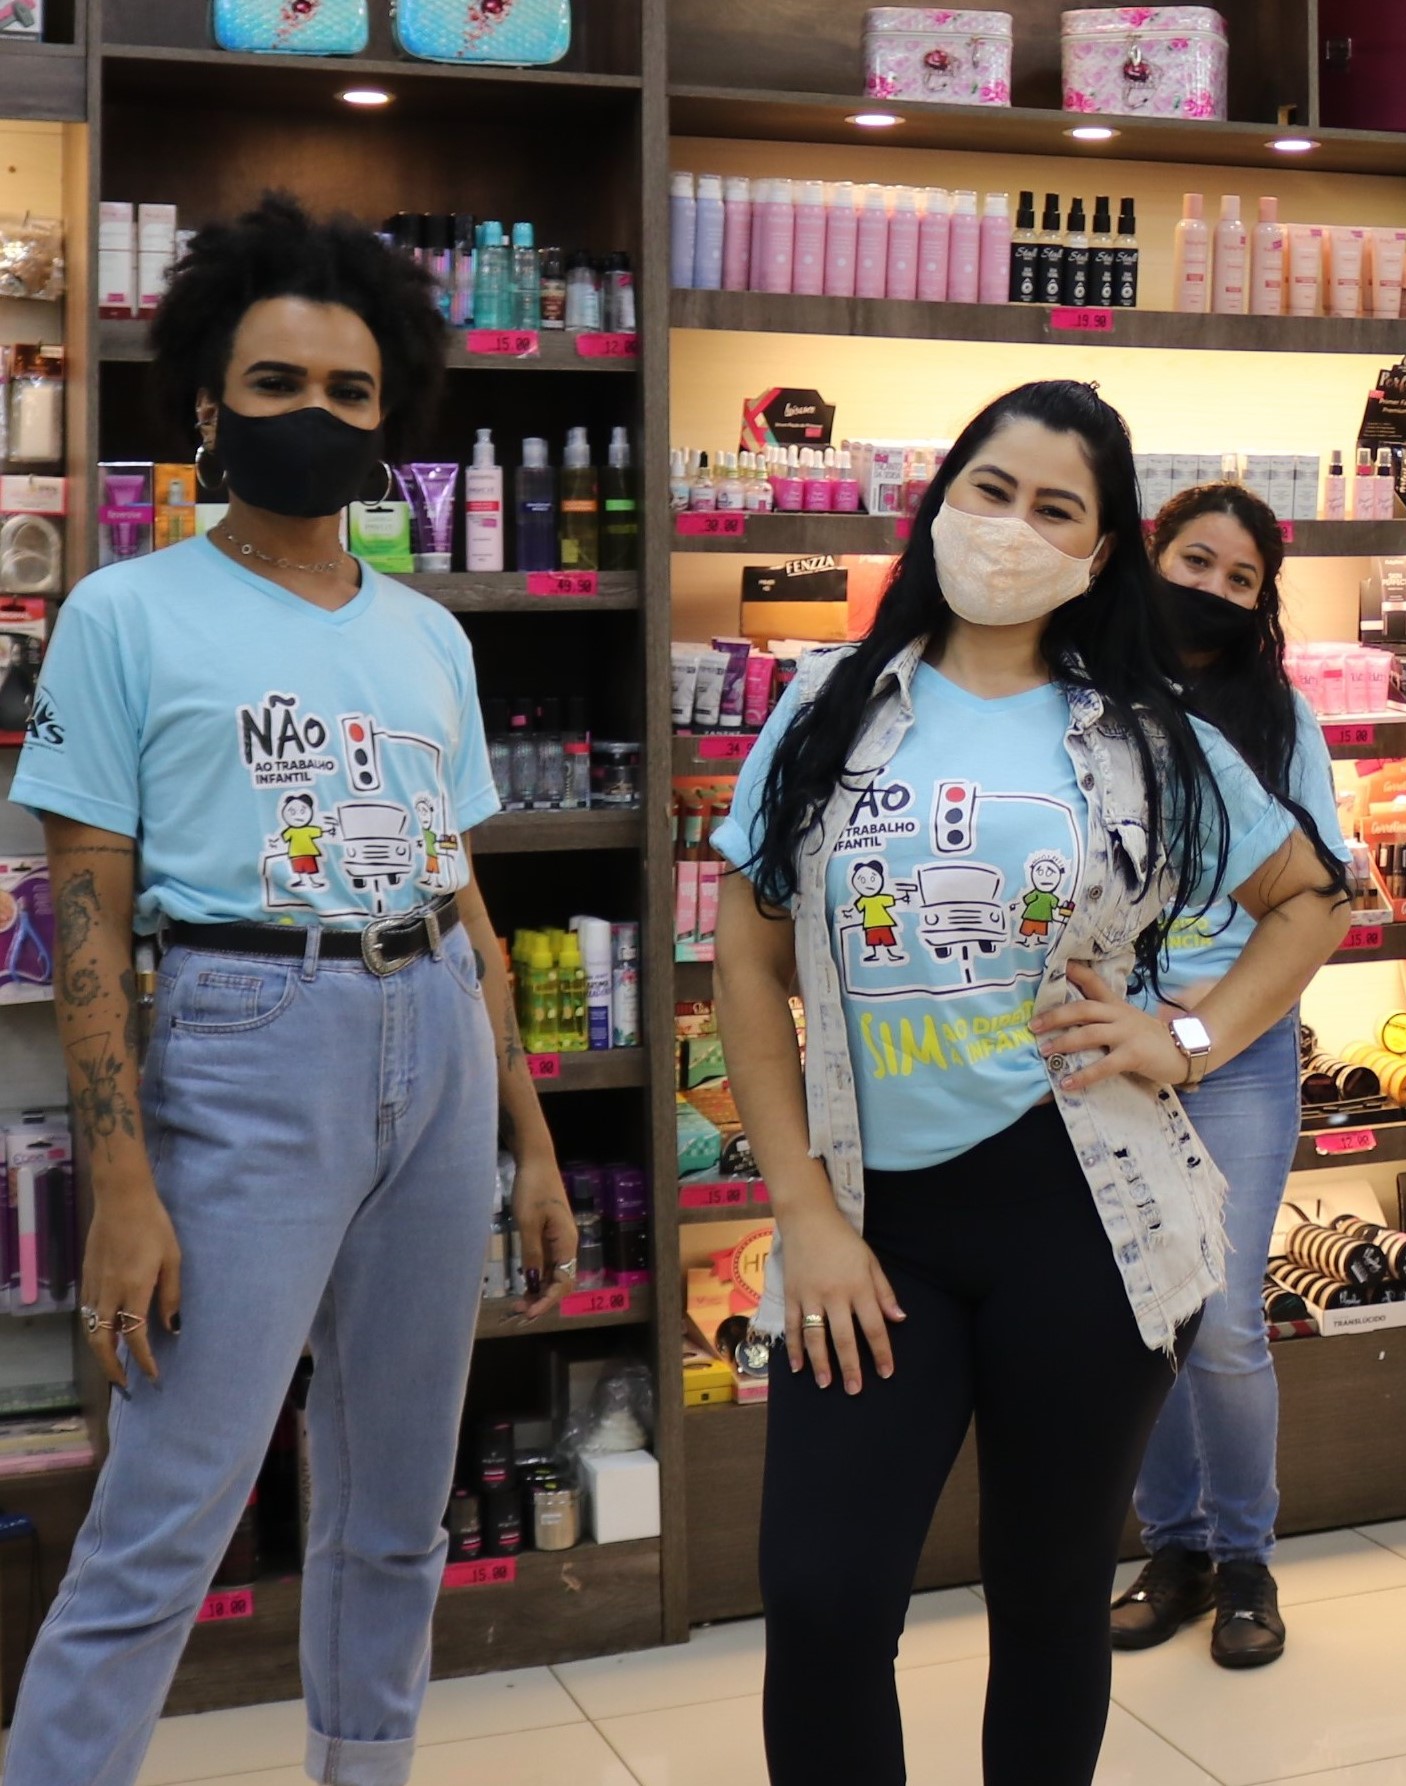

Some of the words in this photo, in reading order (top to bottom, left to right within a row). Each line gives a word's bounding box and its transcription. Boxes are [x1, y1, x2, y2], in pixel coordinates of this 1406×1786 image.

[786, 556, 836, 574] FENZZA
[241, 694, 326, 764] NÃO
[254, 762, 272, 772] AO
[274, 759, 334, 771] TRABALHO
[255, 771, 312, 785] INFANTIL
[846, 821, 915, 837] TRABALHO
[861, 1012, 949, 1080] SIM
